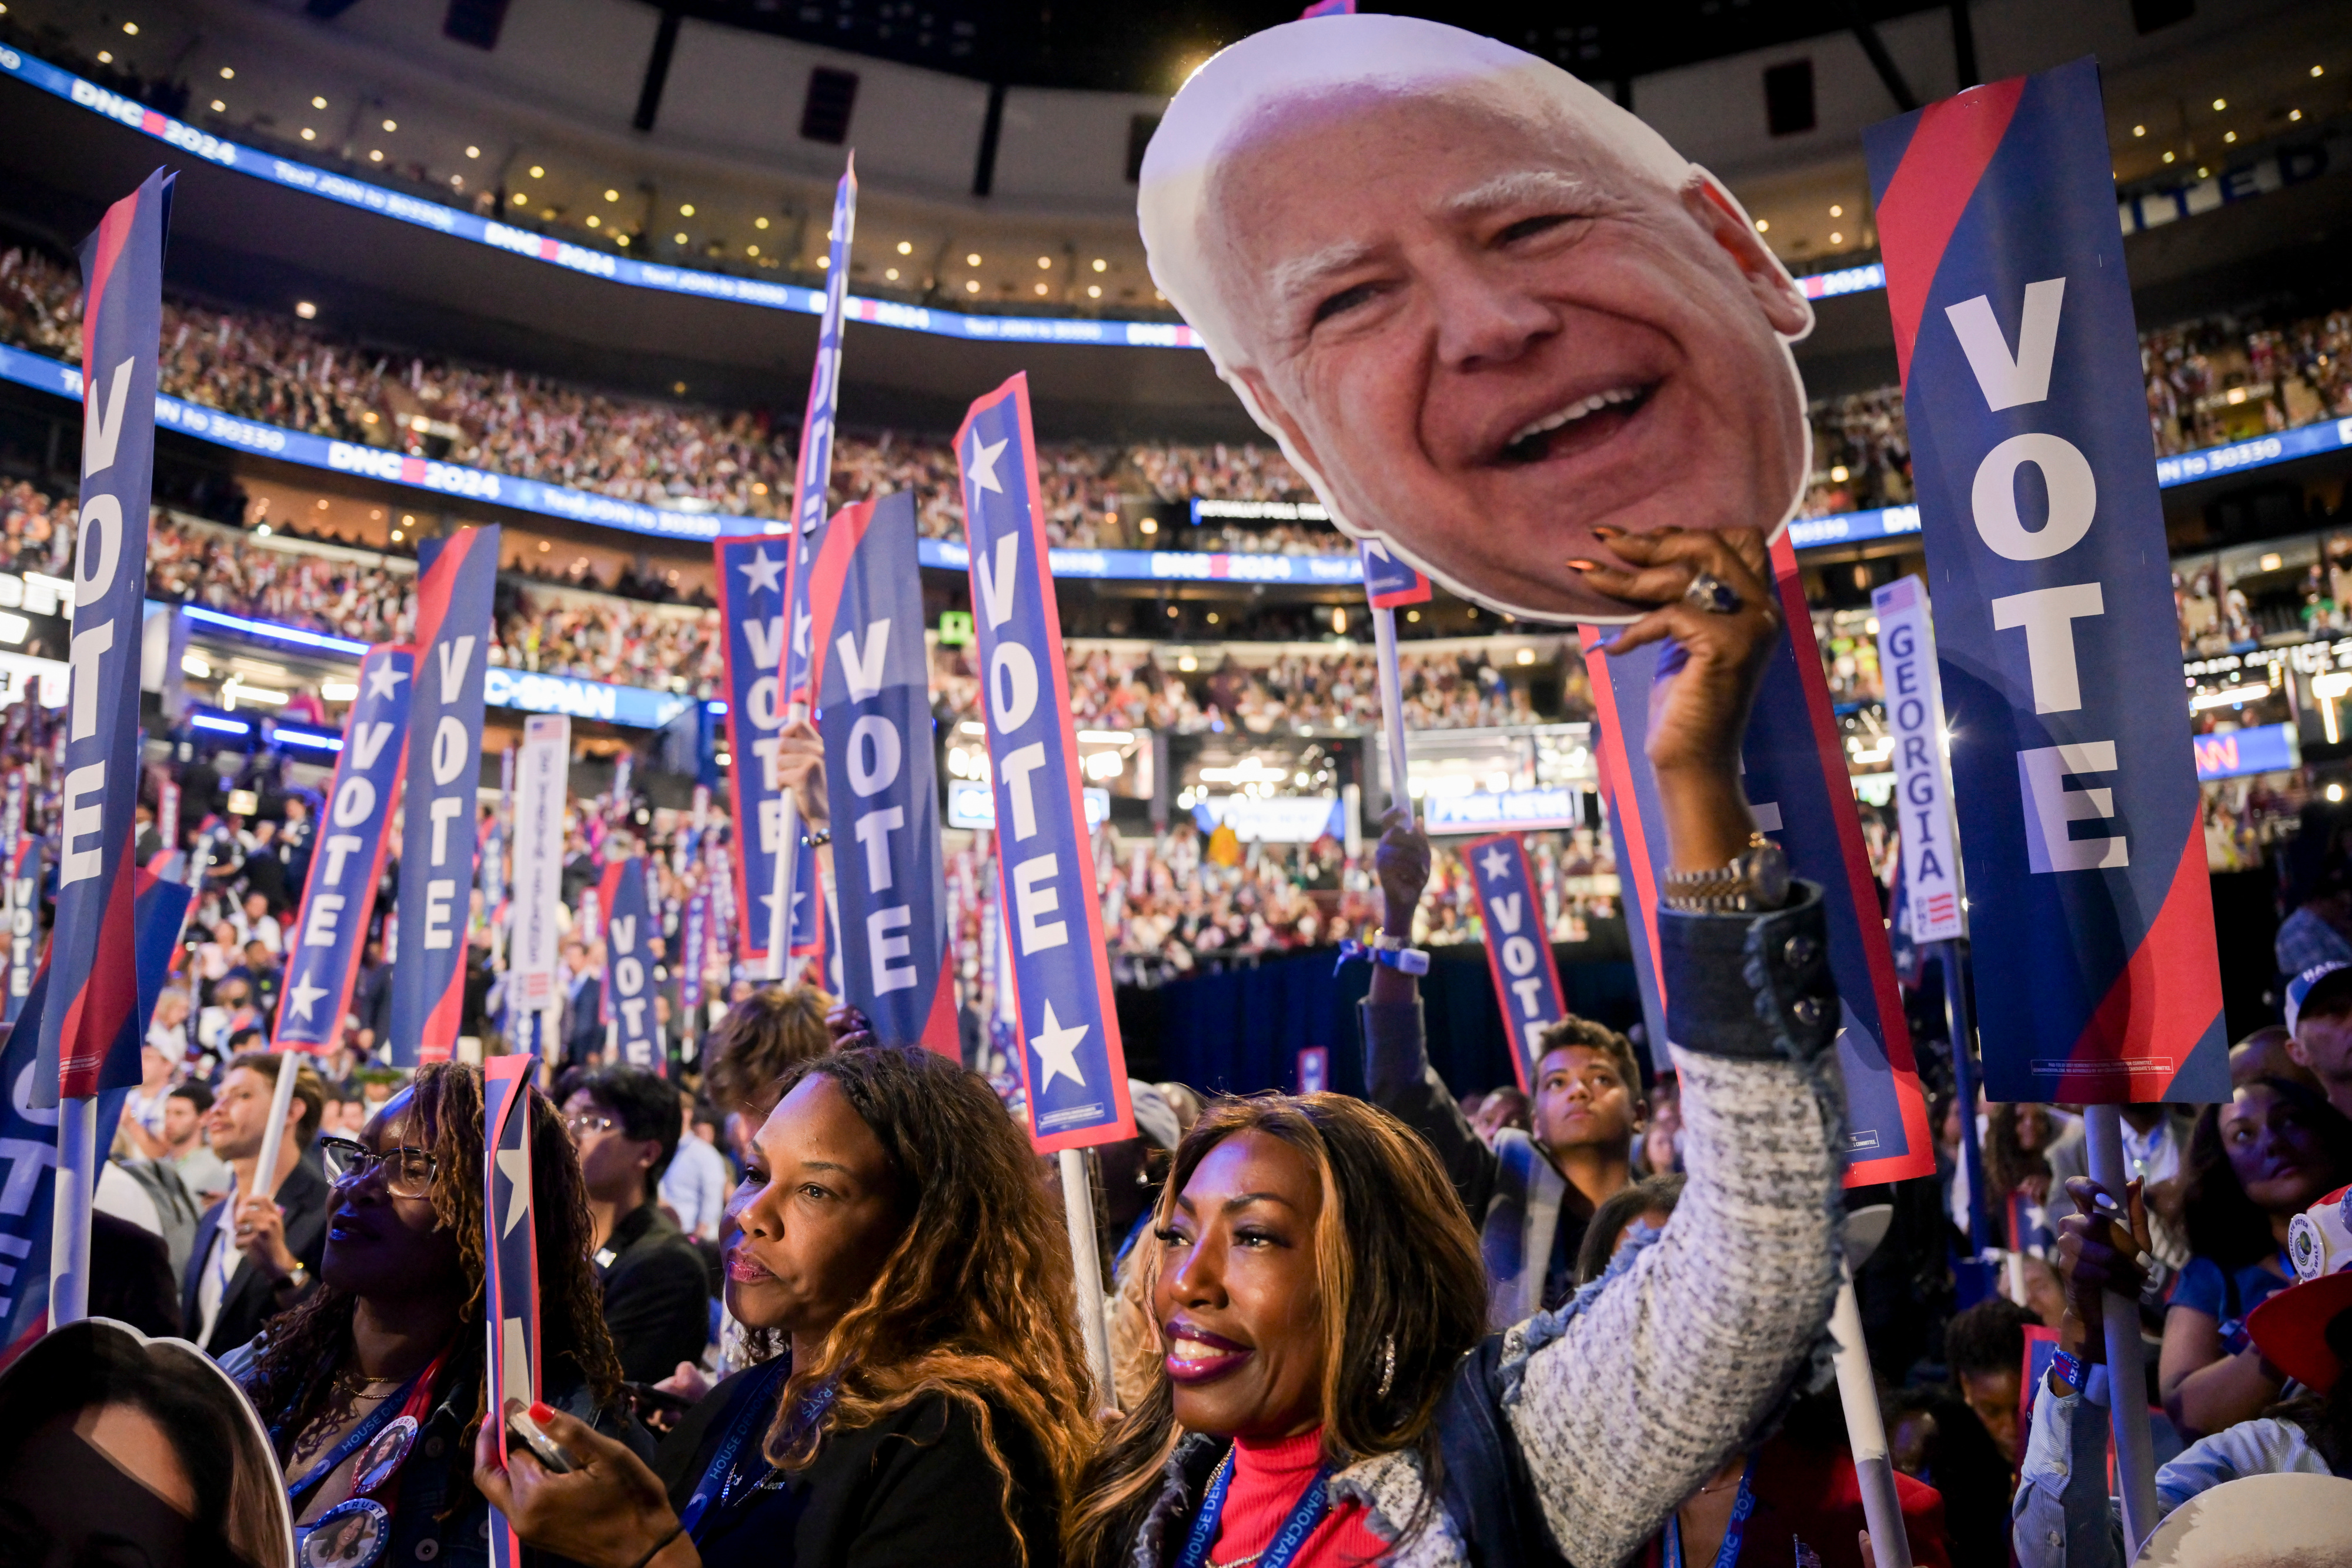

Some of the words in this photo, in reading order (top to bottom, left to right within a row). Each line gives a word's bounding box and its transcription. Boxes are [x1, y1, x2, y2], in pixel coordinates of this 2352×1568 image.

[71, 78, 145, 127] DNC
[163, 119, 238, 165] 2024
[329, 441, 403, 480] DNC
[423, 462, 502, 500] 2024
[1944, 276, 2129, 874] VOTE
[61, 356, 135, 890] VOTE
[484, 668, 616, 719] C-SPAN
[977, 531, 1068, 957] VOTE
[1888, 624, 1944, 882] GEORGIA
[425, 636, 475, 950] VOTE
[836, 618, 917, 998] VOTE
[305, 722, 394, 947] VOTE
[11, 878, 34, 997] VOTE
[2295, 1219, 2309, 1229] VOTER
[2301, 1267, 2316, 1279] HARRIS
[342, 1415, 382, 1452] HOUSE
[709, 1434, 741, 1479] HOUSE
[342, 1500, 383, 1516] TRUST
[764, 1480, 786, 1490] Jeans
[1184, 1513, 1213, 1568] HOUSE
